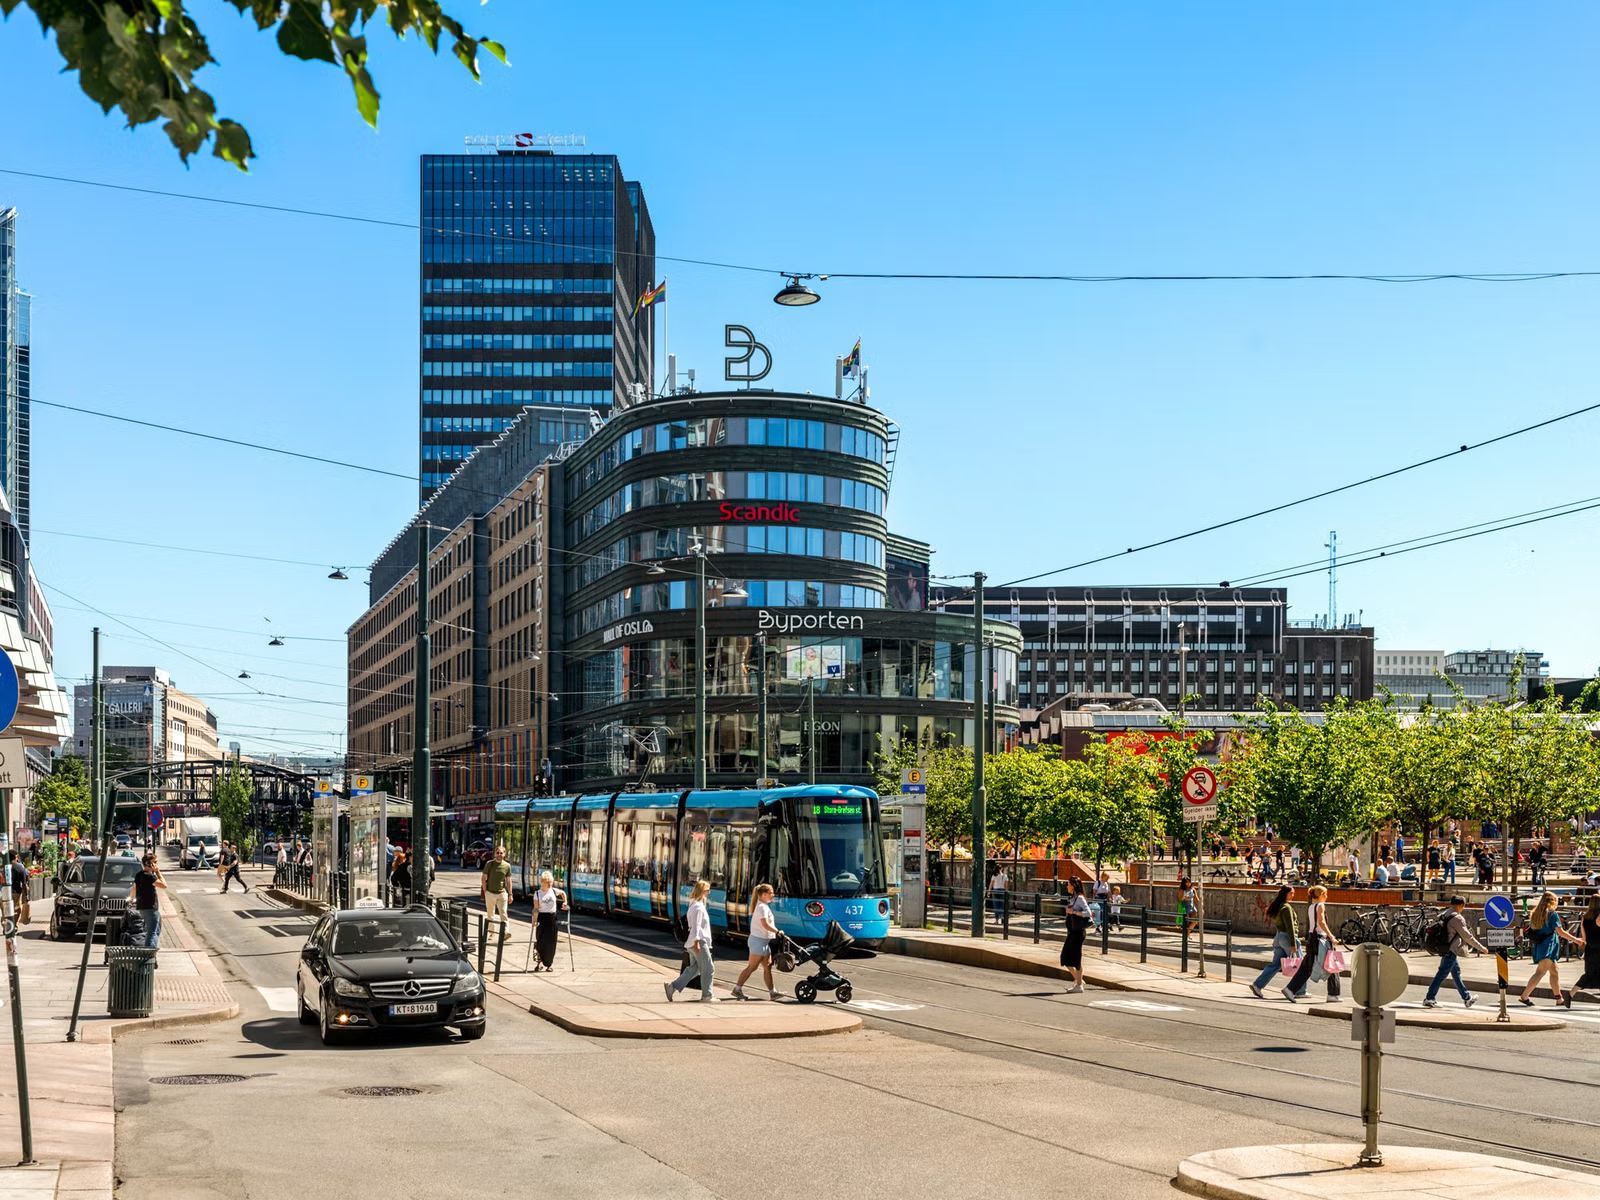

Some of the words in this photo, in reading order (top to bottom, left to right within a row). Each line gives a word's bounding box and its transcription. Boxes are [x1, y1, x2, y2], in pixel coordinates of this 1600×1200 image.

[719, 502, 800, 522] Scandic
[758, 610, 864, 633] Byporten
[845, 905, 864, 915] 437
[396, 1005, 406, 1014] KT
[410, 1004, 435, 1013] 81940
